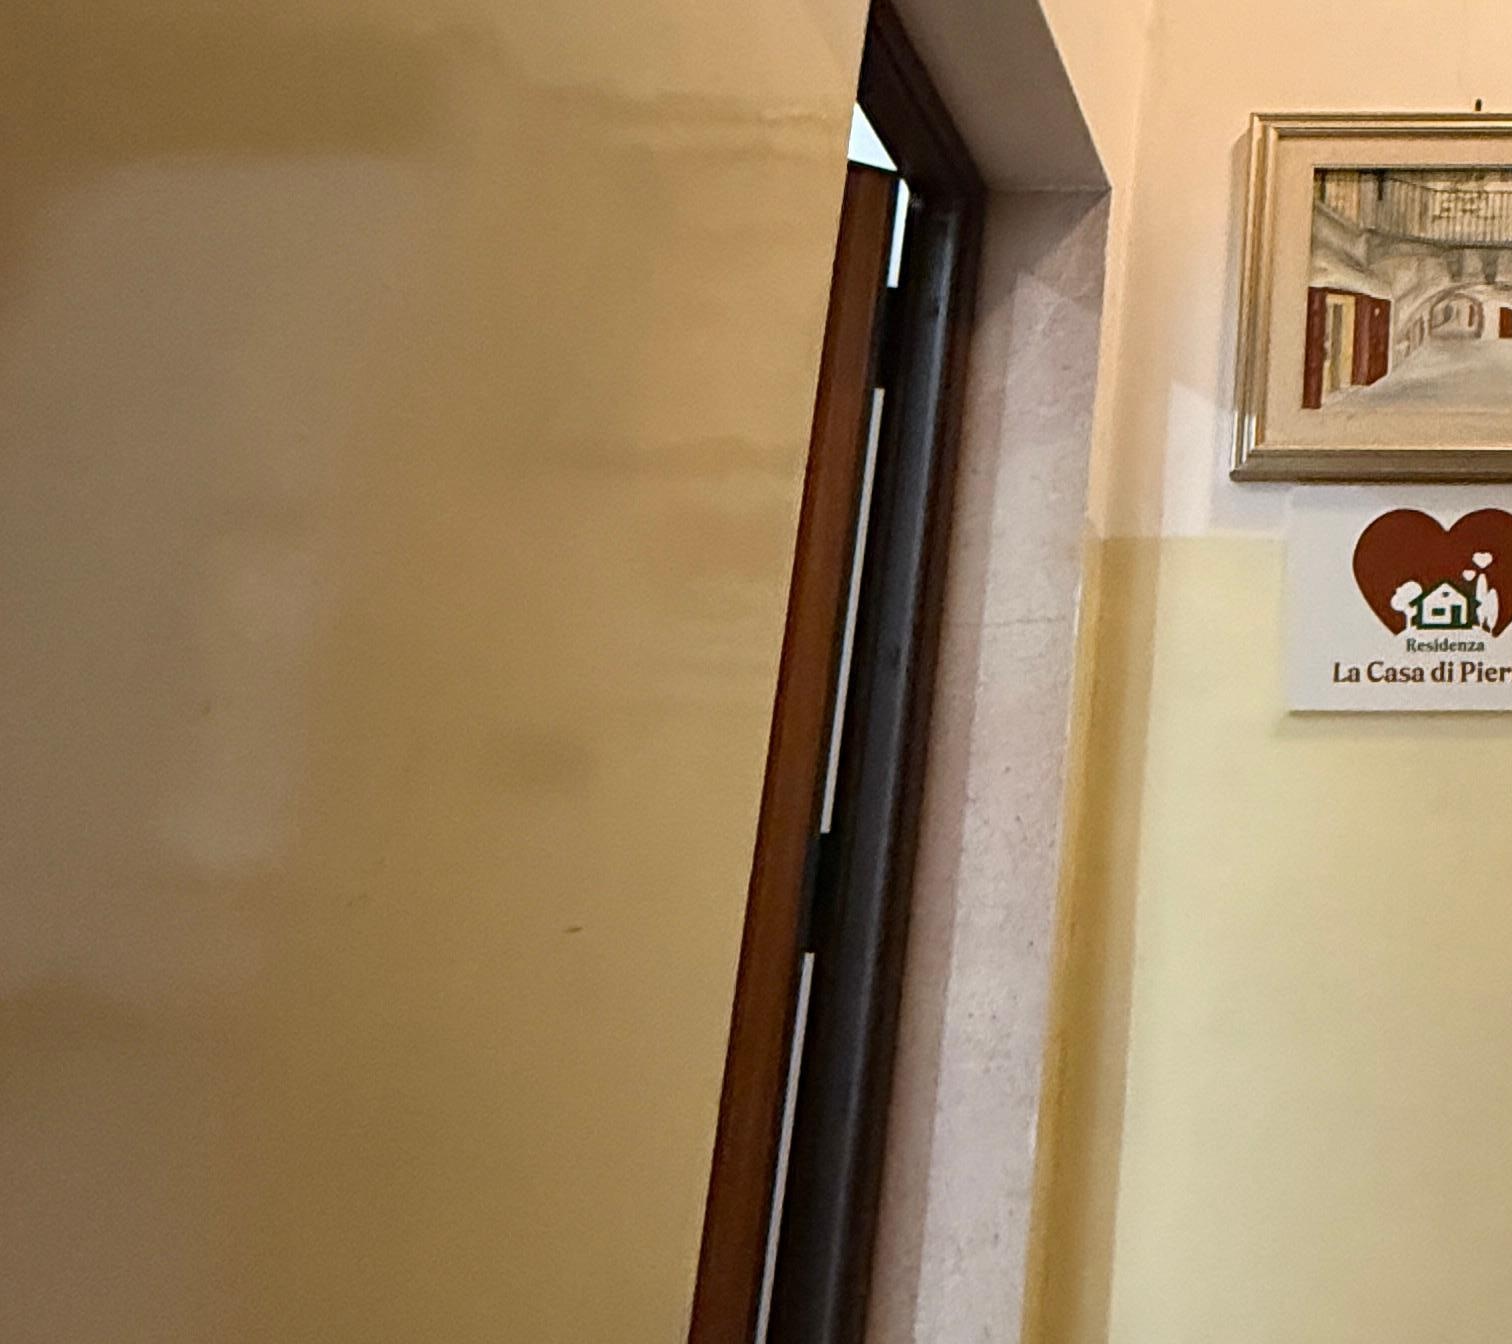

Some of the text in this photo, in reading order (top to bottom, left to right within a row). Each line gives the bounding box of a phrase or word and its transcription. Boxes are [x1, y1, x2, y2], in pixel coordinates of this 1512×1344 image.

[1406, 638, 1485, 653] Residenza
[1333, 662, 1361, 683] La
[1367, 661, 1425, 683] Casa
[1431, 661, 1454, 683] di
